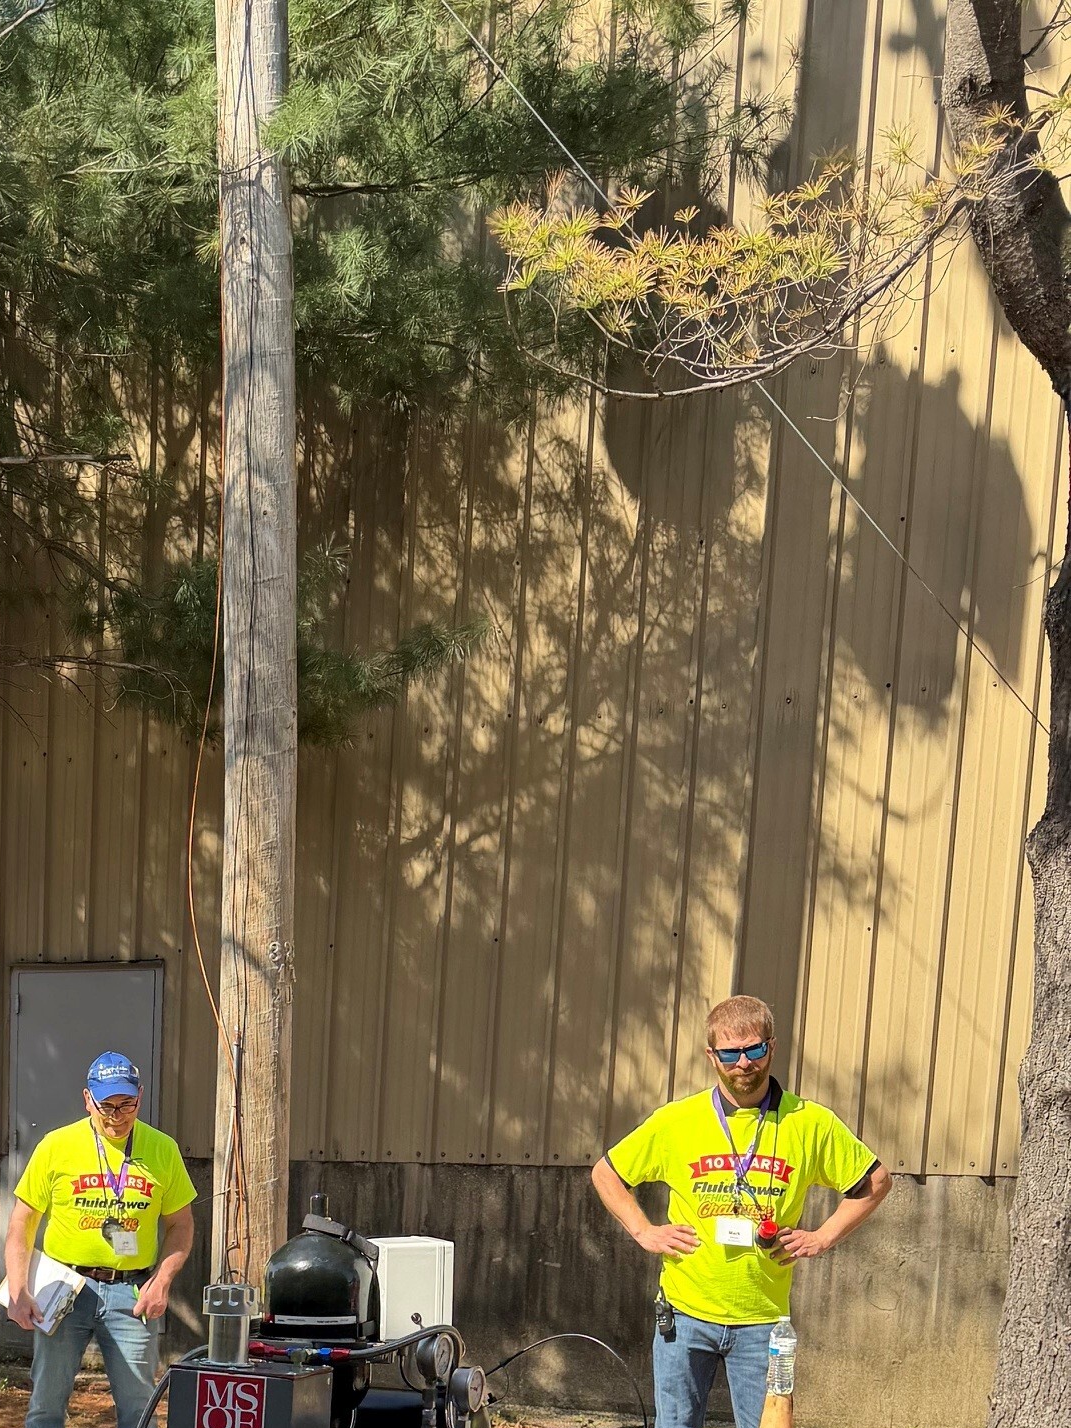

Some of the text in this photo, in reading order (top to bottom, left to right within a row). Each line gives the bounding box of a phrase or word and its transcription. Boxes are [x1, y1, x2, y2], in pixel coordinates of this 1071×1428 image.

[705, 1157, 781, 1172] 10 YARS
[83, 1176, 143, 1188] 10 YRS
[692, 1181, 786, 1197] Fluid ower
[74, 1197, 150, 1210] Fluid Power
[203, 1379, 259, 1412] MS
